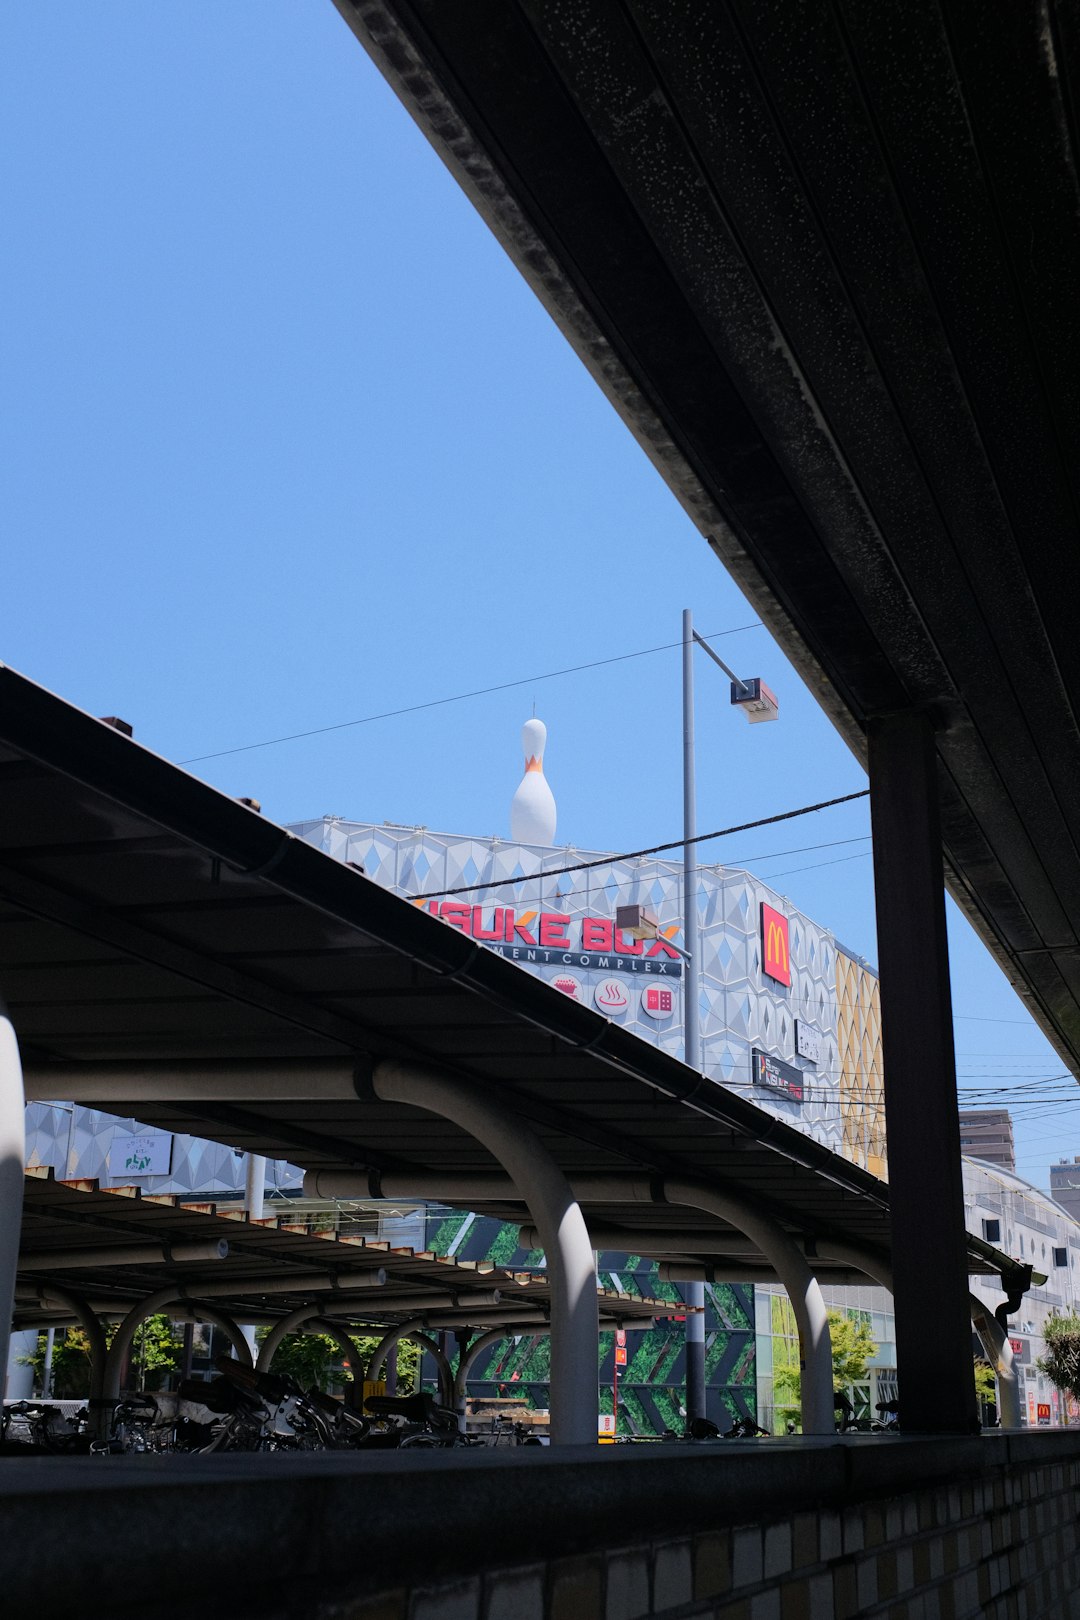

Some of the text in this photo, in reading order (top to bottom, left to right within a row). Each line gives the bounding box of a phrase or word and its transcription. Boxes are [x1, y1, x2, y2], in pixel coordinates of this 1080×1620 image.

[491, 946, 668, 974] MENT COMPLEX
[126, 1154, 151, 1171] PLAY
